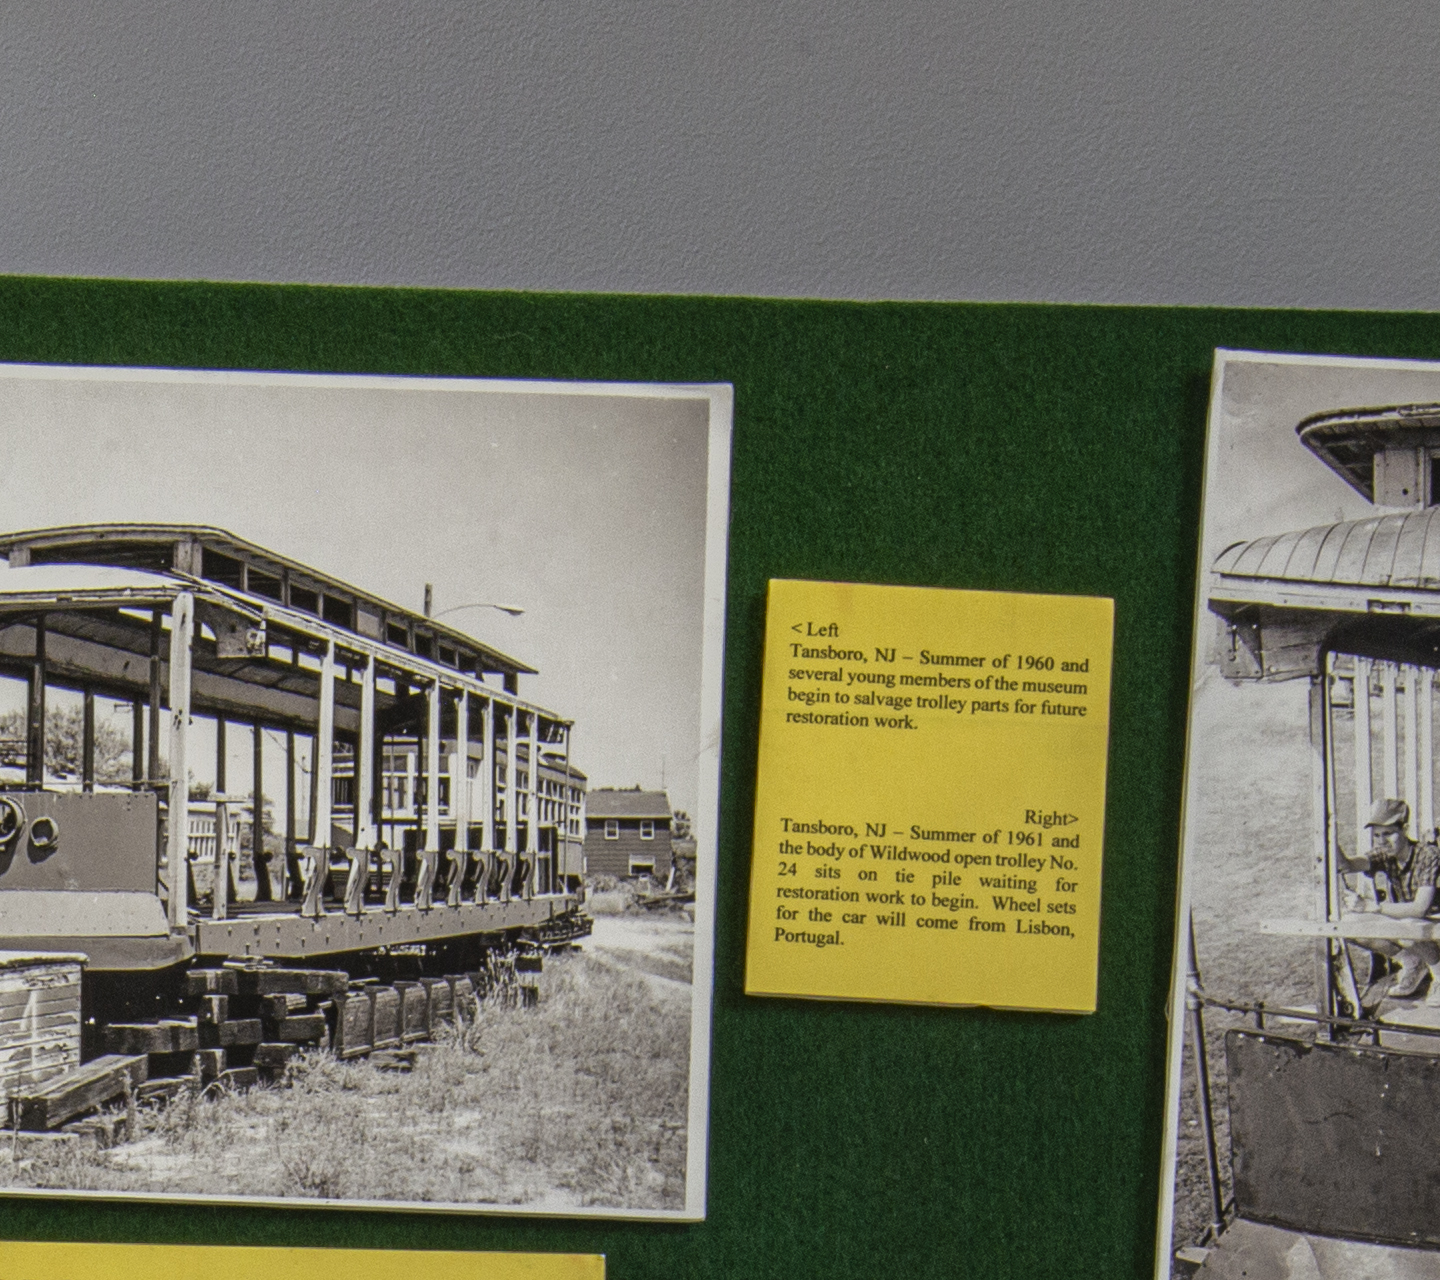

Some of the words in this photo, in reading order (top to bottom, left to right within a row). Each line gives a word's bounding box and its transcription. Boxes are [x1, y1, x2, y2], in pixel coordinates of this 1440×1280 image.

[788, 686, 830, 706] begin
[835, 692, 850, 704] to
[854, 691, 912, 711] salvage
[917, 695, 967, 714] trolley
[971, 700, 1009, 715] parts
[1014, 698, 1037, 714] for
[1041, 700, 1087, 717] future
[786, 711, 869, 727] restoration
[874, 714, 918, 730] work.
[779, 839, 803, 855] the
[807, 841, 845, 861] body
[848, 844, 868, 859] of
[870, 845, 950, 863] Wildwood
[954, 854, 992, 869] open
[995, 853, 1046, 872] trolley
[1050, 855, 1077, 870] No.
[776, 905, 799, 920] for
[808, 907, 832, 923] the
[841, 913, 867, 924] car
[876, 911, 906, 927] will
[916, 917, 958, 930] come
[969, 916, 1006, 933] from
[1016, 919, 1075, 938] Lisbon,
[774, 927, 844, 948] Portugal.
